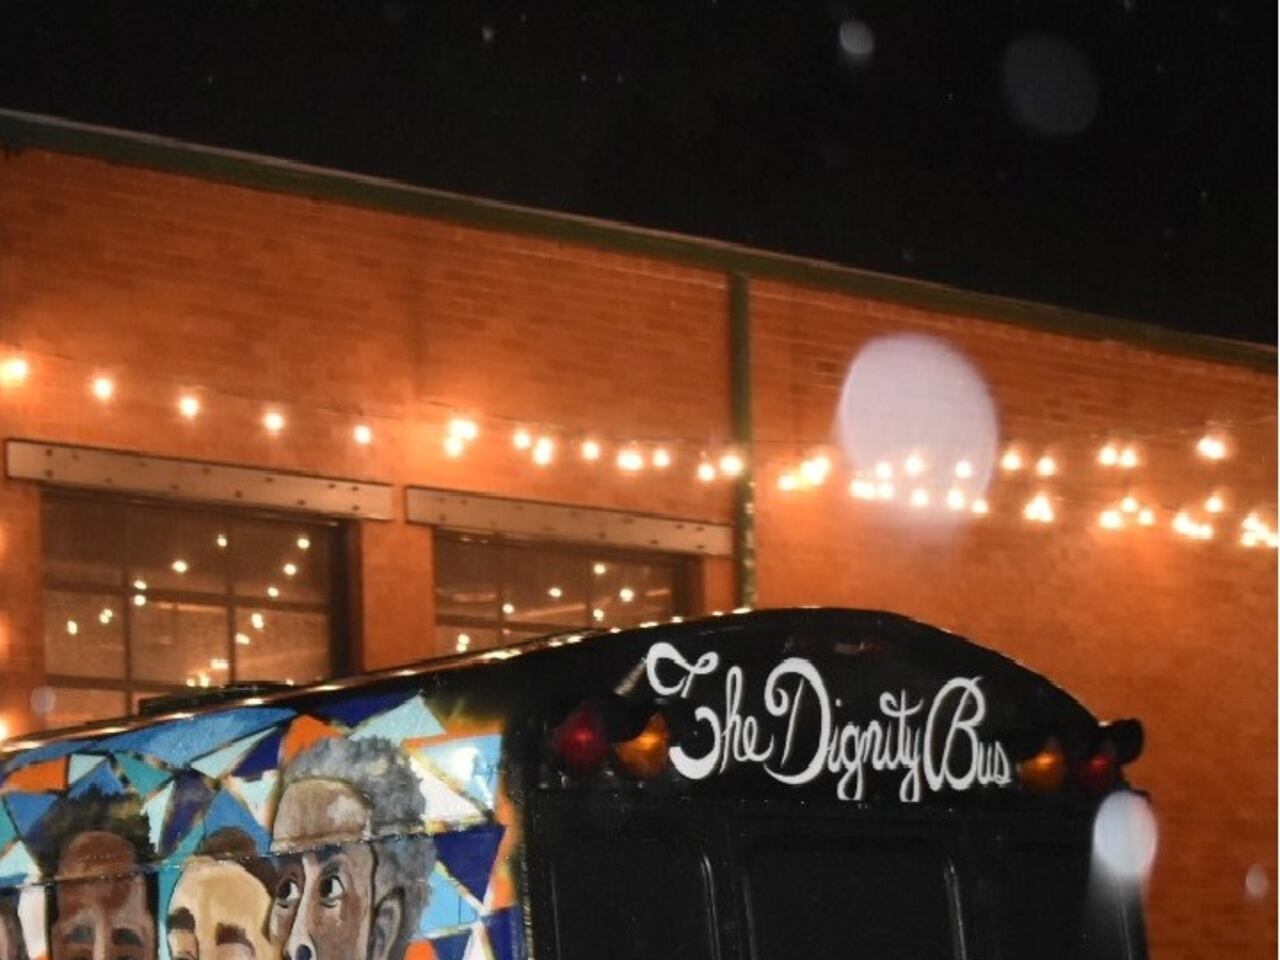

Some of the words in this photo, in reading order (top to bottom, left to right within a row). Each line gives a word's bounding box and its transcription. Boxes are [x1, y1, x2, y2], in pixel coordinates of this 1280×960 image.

[646, 641, 775, 780] The
[763, 657, 924, 803] Dignity
[922, 675, 1011, 791] Bus
